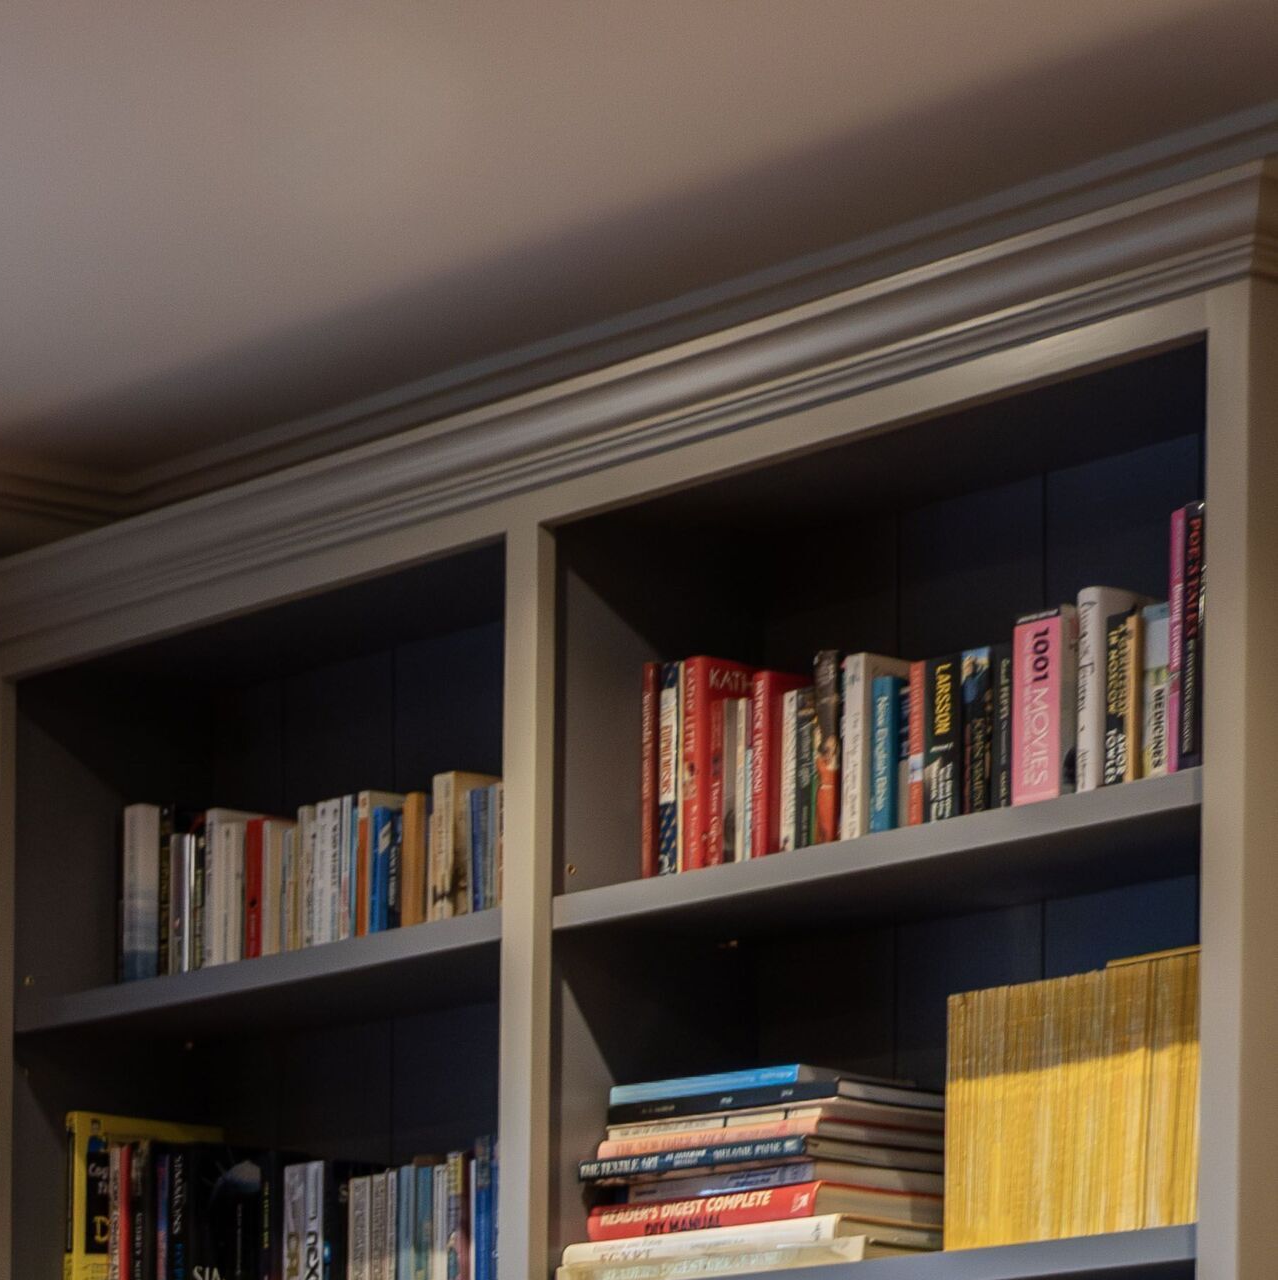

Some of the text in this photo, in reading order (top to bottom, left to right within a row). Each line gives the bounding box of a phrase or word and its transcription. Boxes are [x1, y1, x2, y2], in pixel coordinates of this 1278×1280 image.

[934, 662, 952, 737] LARSSON
[1031, 627, 1050, 786] 1001 MOVIES
[1152, 688, 1165, 770] MEDICINES
[600, 1190, 773, 1227] READER'S DIGEST COMPLETE
[671, 1214, 722, 1233] MANUAL
